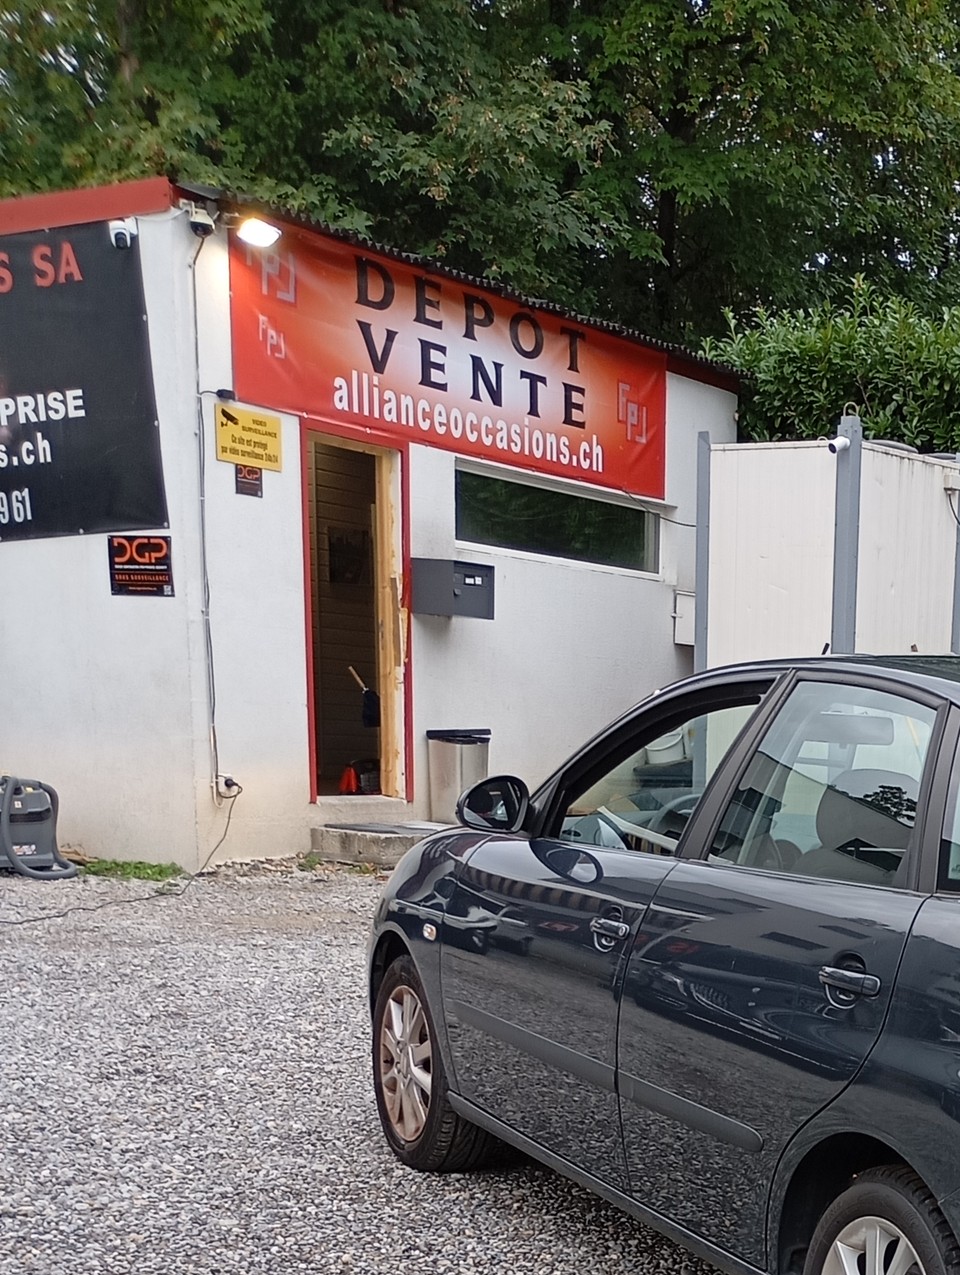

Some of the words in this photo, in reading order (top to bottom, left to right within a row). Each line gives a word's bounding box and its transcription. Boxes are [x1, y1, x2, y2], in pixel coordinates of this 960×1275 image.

[32, 240, 83, 288] SA
[356, 319, 587, 430] VENTE
[333, 370, 604, 473] allianceoccasions.ch
[113, 537, 167, 563] DGP
